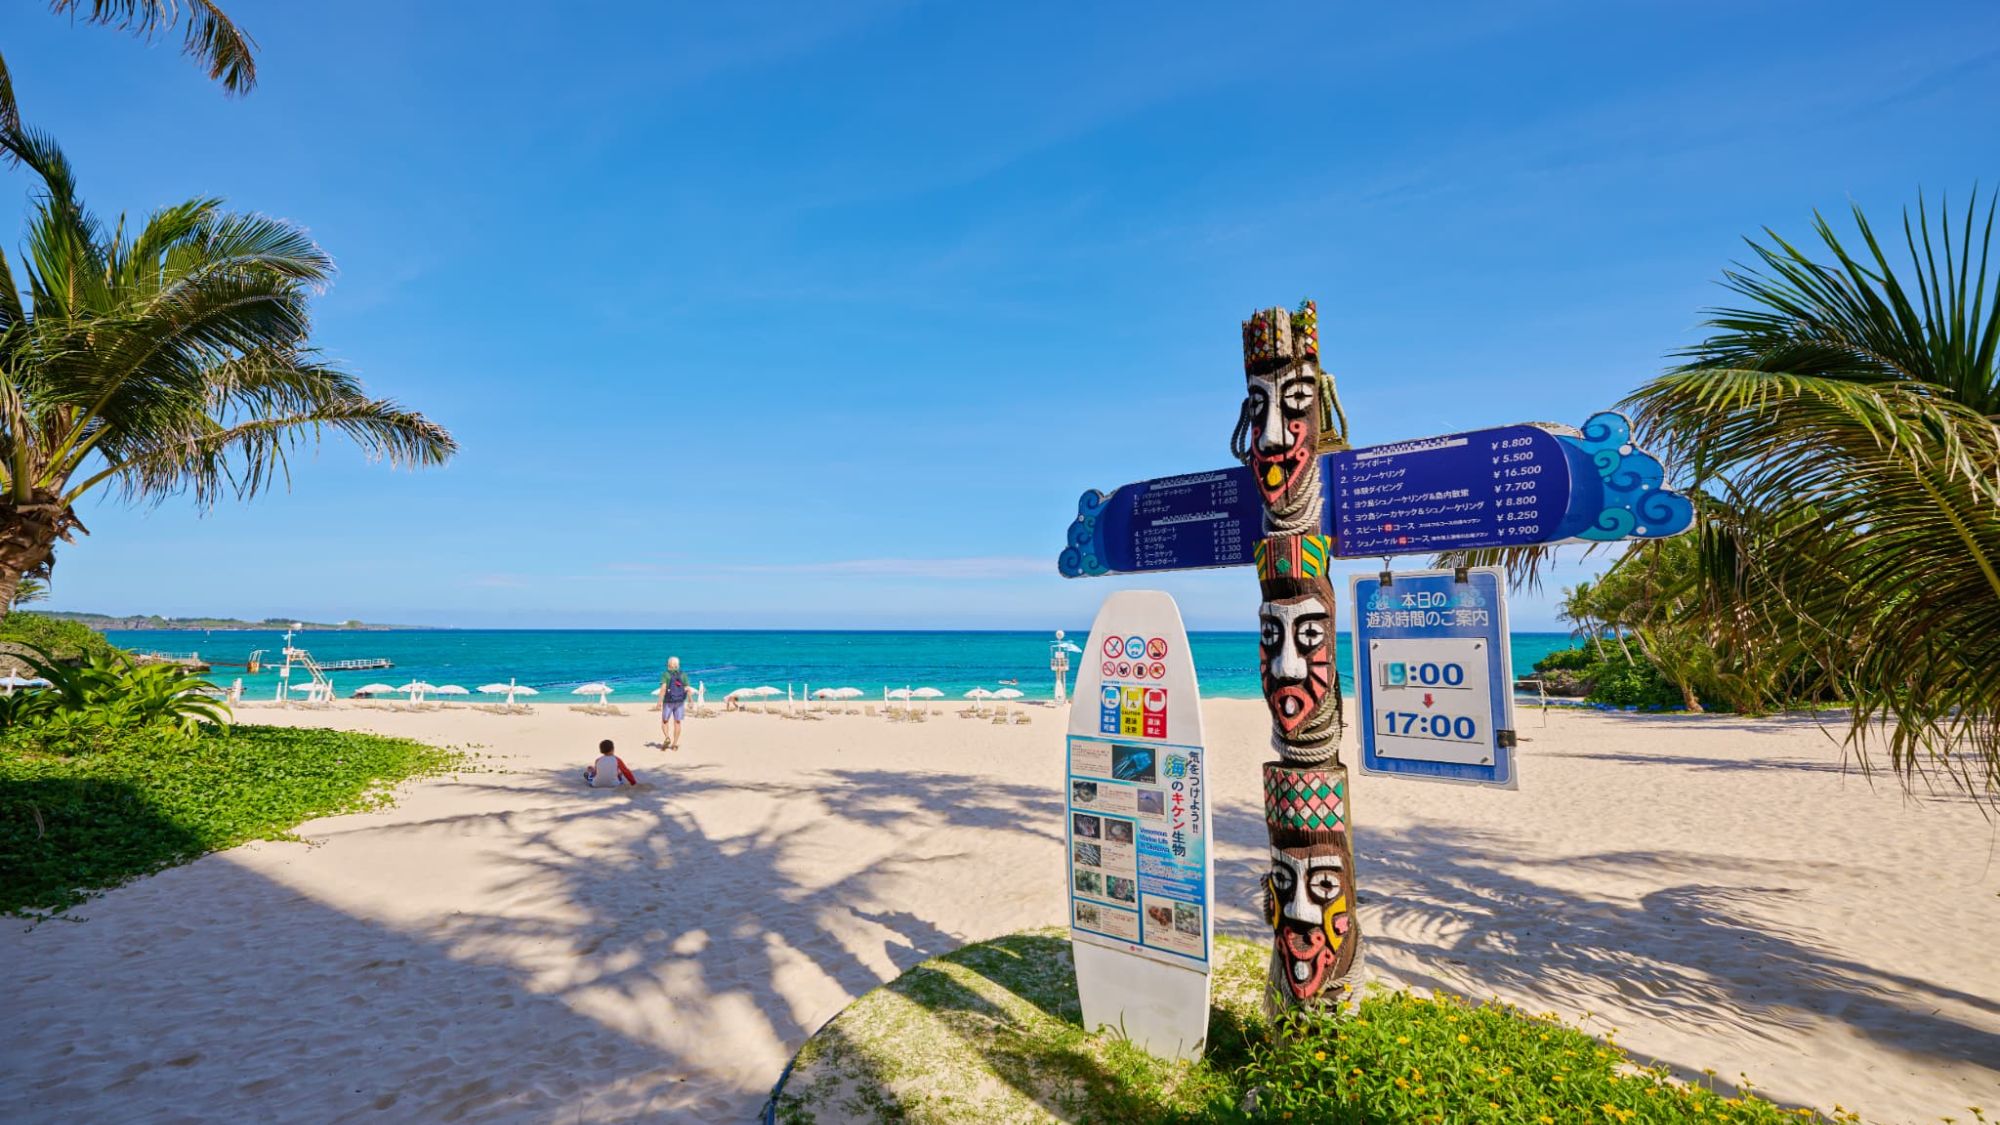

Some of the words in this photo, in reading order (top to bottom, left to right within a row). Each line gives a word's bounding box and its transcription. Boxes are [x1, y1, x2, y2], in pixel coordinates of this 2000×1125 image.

[1340, 463, 1348, 471] 1.
[1352, 457, 1393, 470] フライボード
[1502, 437, 1532, 448] 8.800
[1340, 476, 1348, 484] 2.
[1352, 468, 1406, 482] シュノーケリング
[1503, 452, 1534, 462] 5.500
[1342, 489, 1349, 497] 3.
[1504, 465, 1542, 478] 16.500
[1342, 502, 1350, 510] 4.
[1505, 481, 1536, 492] 7.700
[1344, 514, 1351, 522] 5.
[1506, 496, 1536, 506] 8.800
[1507, 510, 1538, 520] 8.250
[1508, 525, 1539, 536] 9.900
[1401, 592, 1446, 609] 本日の
[1366, 610, 1489, 628] 遊泳時間のご案内
[1389, 662, 1464, 686] 9:00
[1385, 712, 1476, 740] 17:00
[1164, 754, 1186, 858] 海のキケン生物
